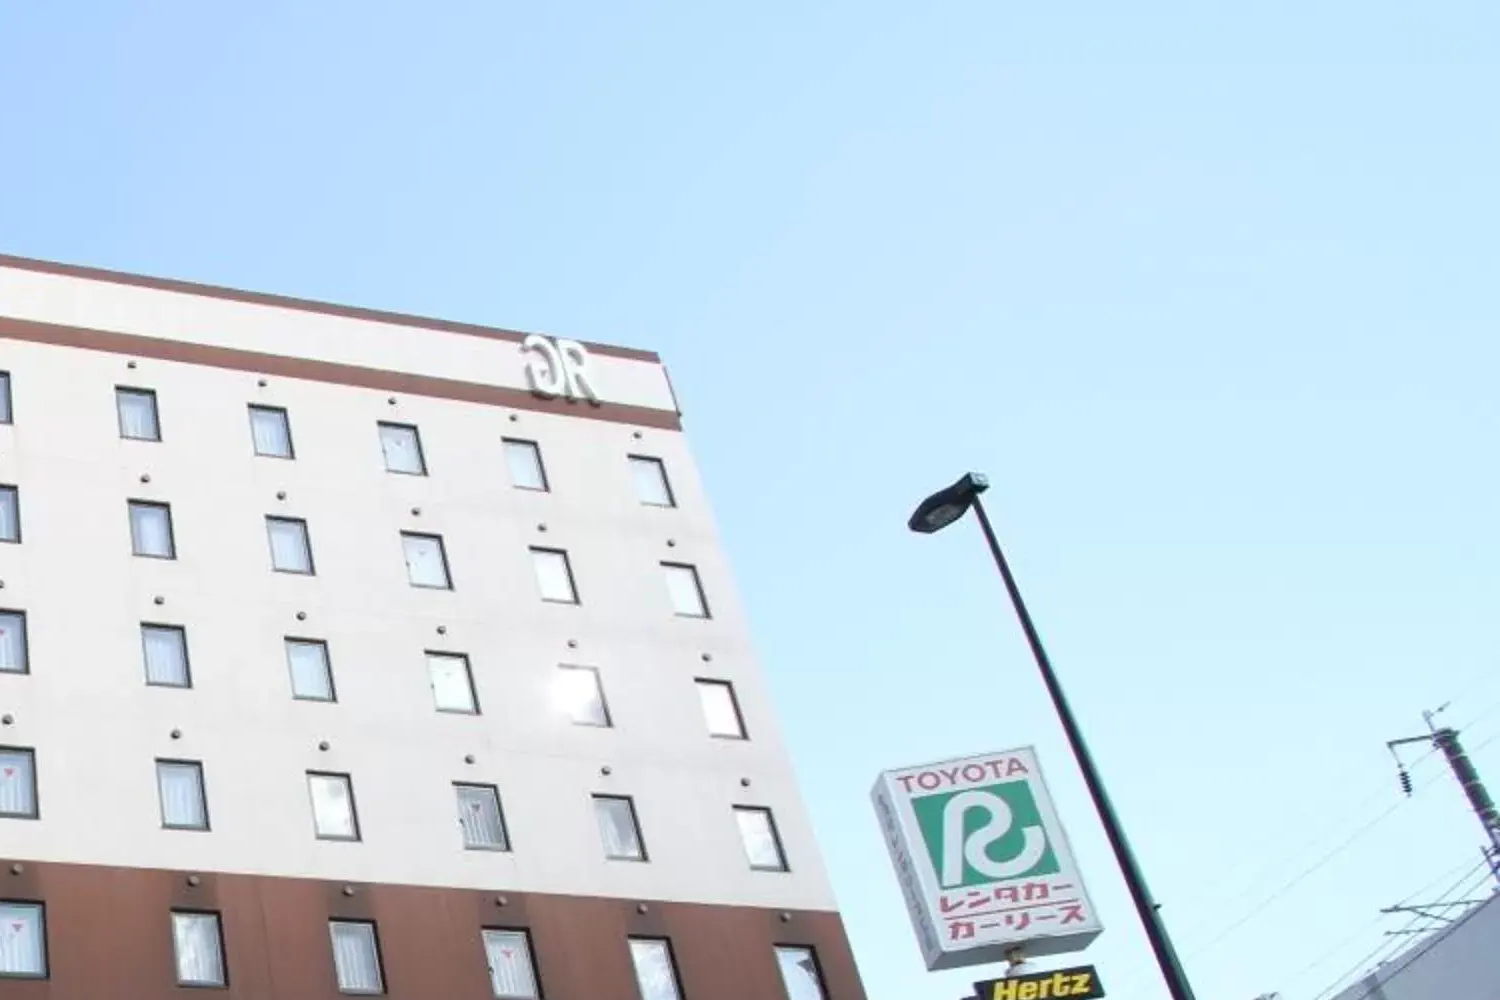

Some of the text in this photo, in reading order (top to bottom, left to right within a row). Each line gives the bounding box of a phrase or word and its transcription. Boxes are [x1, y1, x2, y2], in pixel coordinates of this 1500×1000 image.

[896, 757, 1029, 793] TOYOTA
[939, 882, 1075, 914] レンタカー
[948, 903, 1087, 941] カーリース
